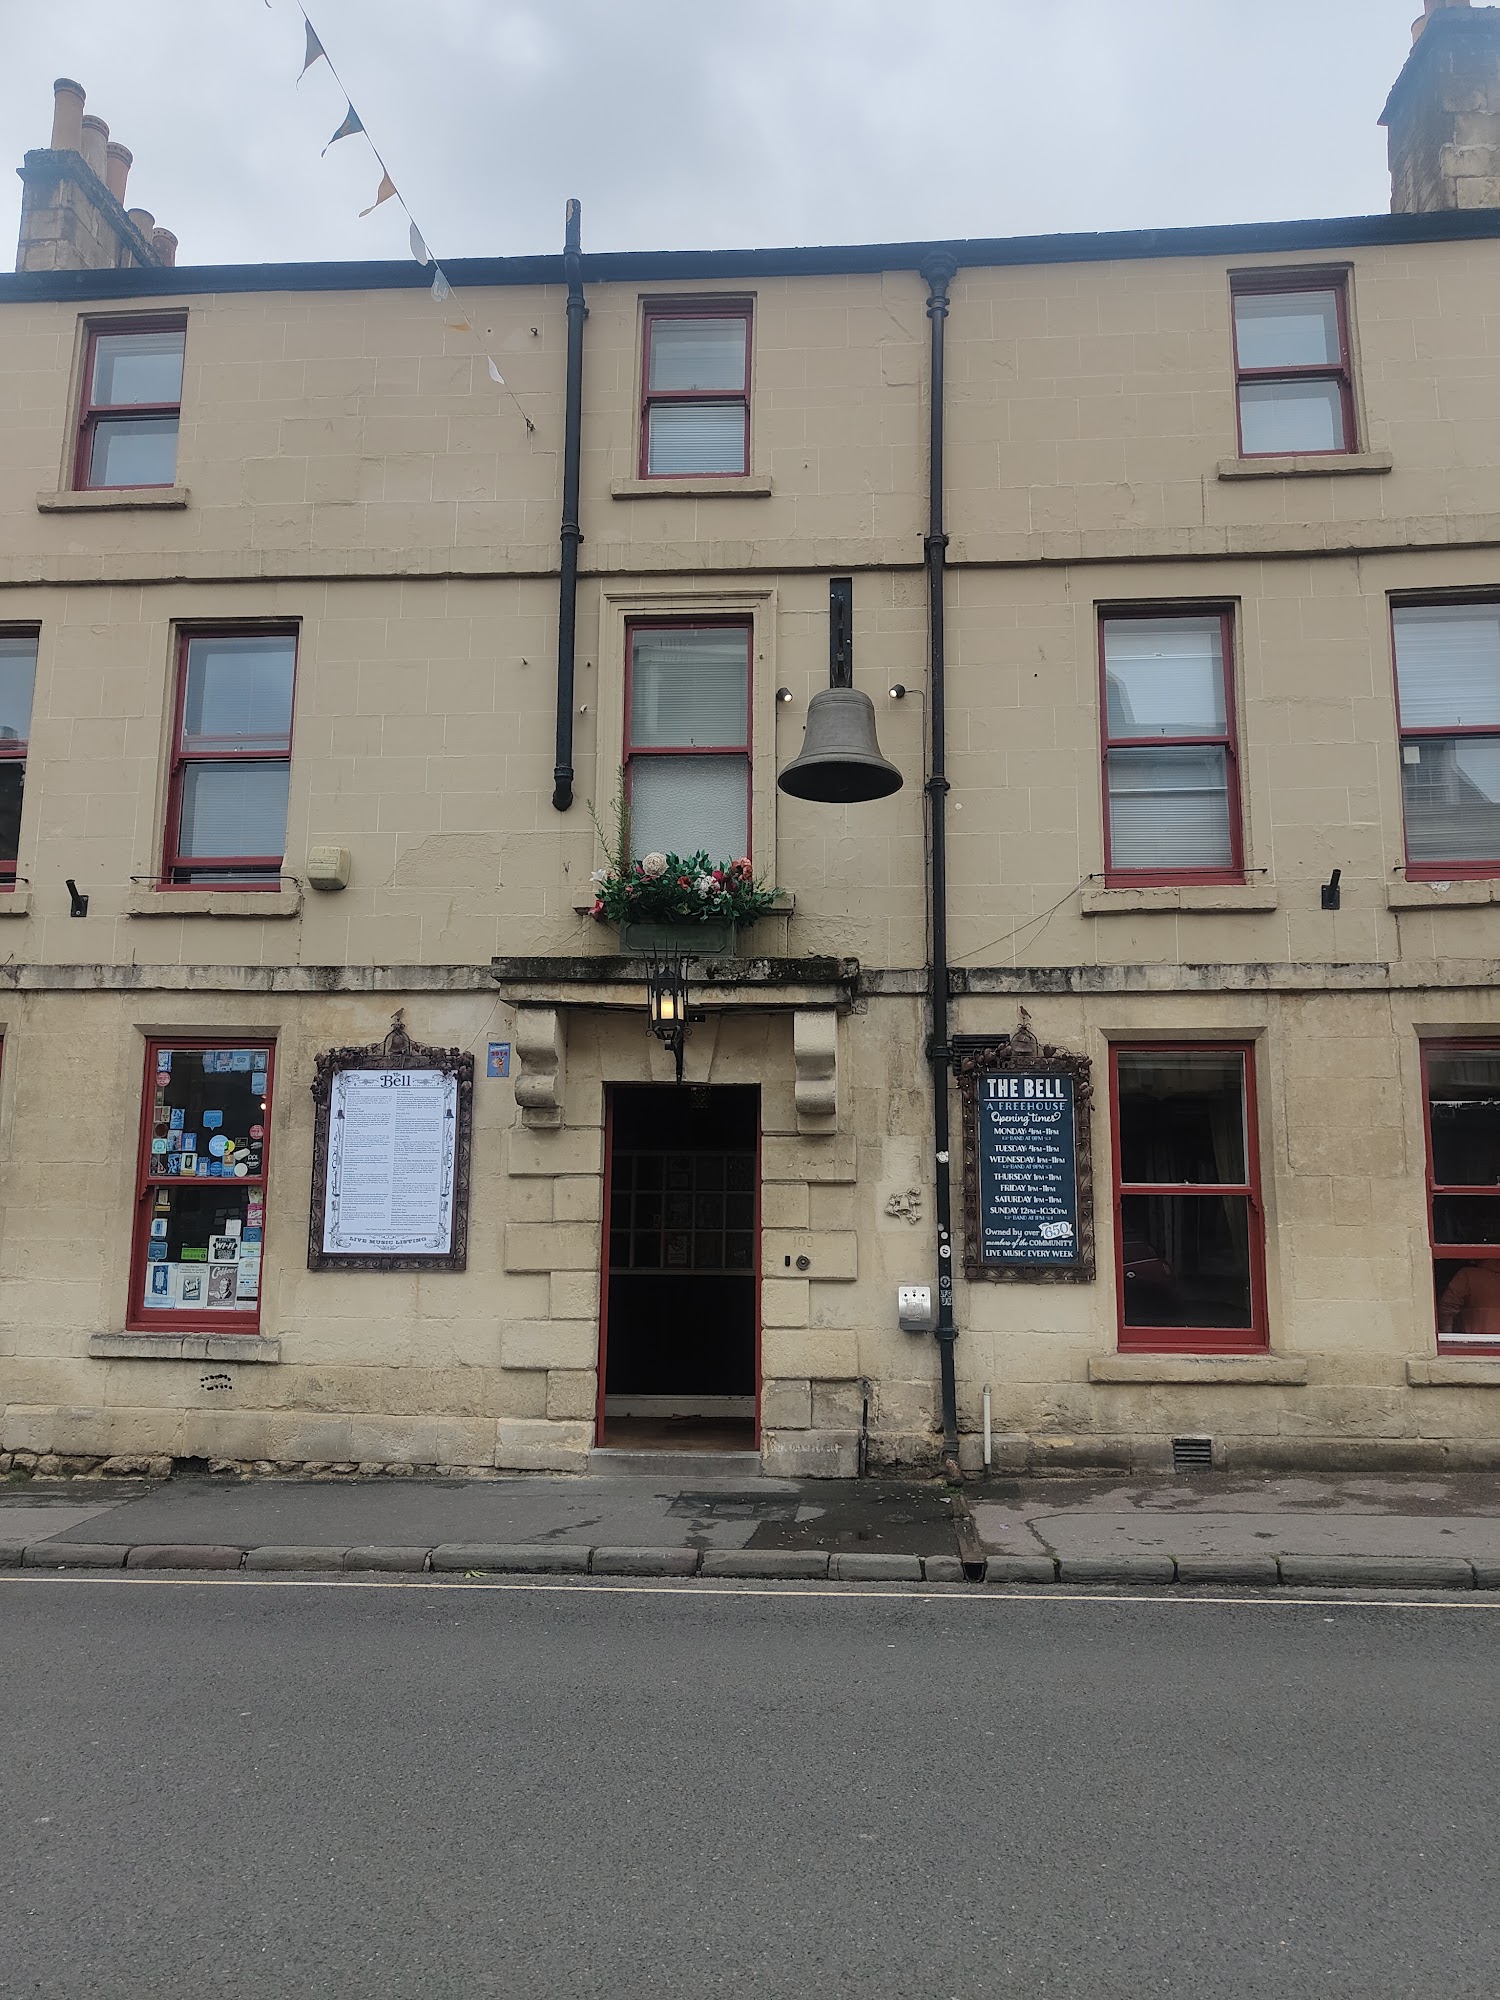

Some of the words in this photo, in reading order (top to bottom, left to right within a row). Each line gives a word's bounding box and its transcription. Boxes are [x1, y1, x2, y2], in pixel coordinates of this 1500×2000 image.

[380, 1075, 411, 1088] Bell
[987, 1078, 1018, 1098] THE
[1024, 1078, 1064, 1098] BELL
[986, 1102, 994, 1110] A
[998, 1102, 1066, 1110] FREEHOUSE
[991, 1111, 1030, 1126] Opening
[1027, 1111, 1061, 1122] times
[1000, 1184, 1026, 1192] FRIDAY
[995, 1195, 1032, 1203] SATURDAY
[985, 1228, 1011, 1236] Owned
[1012, 1228, 1022, 1238] by
[1045, 1222, 1069, 1238] 650
[986, 1238, 1011, 1246] members
[1011, 1238, 1020, 1248] of
[1019, 1238, 1028, 1246] the
